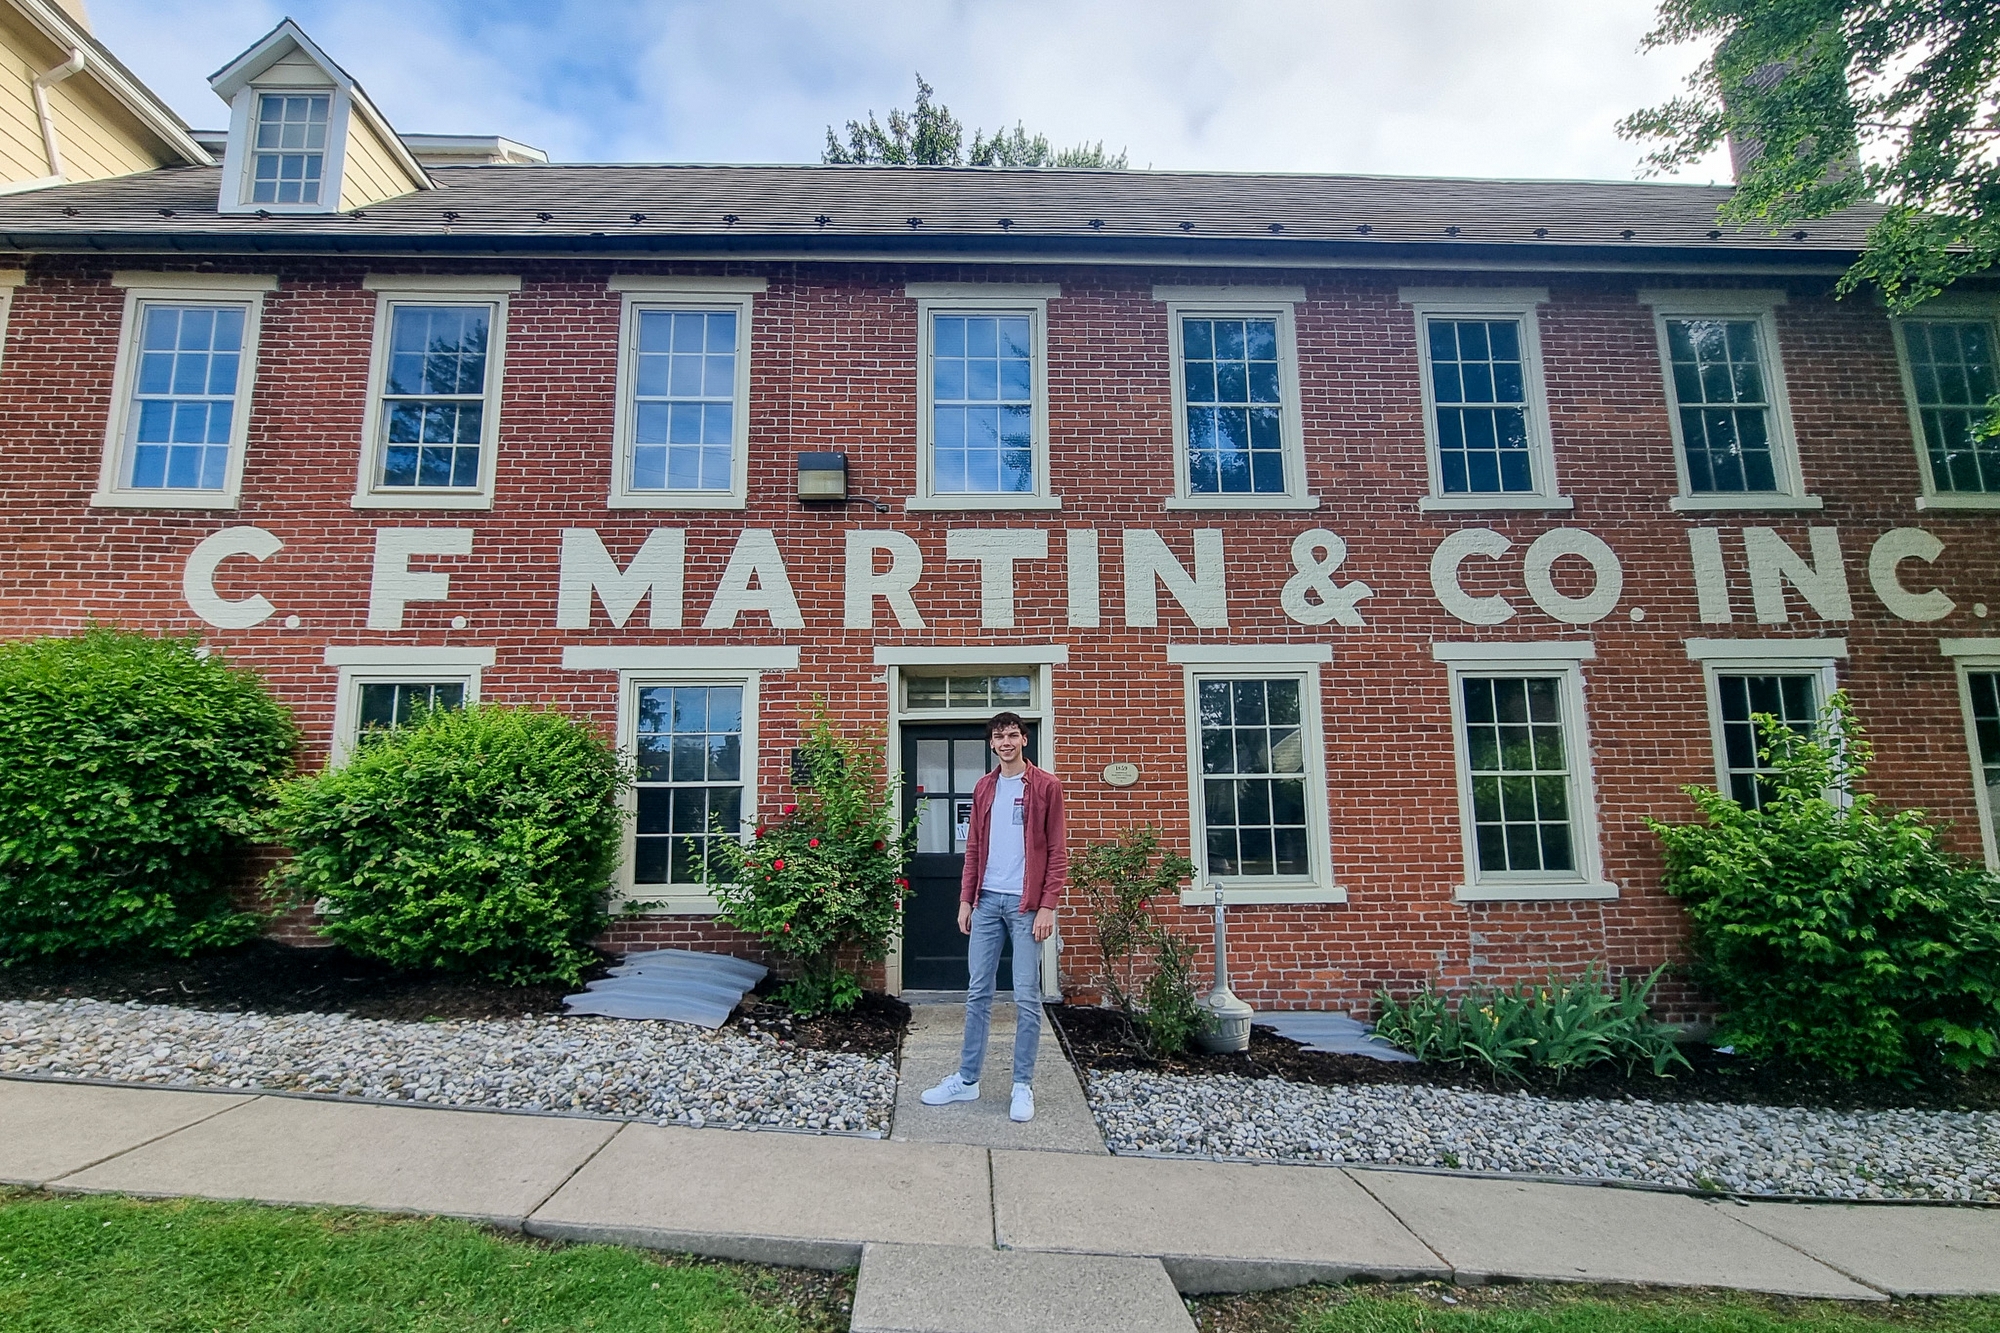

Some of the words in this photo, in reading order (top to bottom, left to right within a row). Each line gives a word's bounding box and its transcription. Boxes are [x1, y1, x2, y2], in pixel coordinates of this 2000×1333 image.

[183, 526, 301, 630] C.
[366, 527, 474, 630] F.
[556, 527, 1229, 630] MARTIN
[1281, 528, 1374, 626] &
[1430, 527, 1646, 625] CO.
[1687, 526, 1988, 625] INC.
